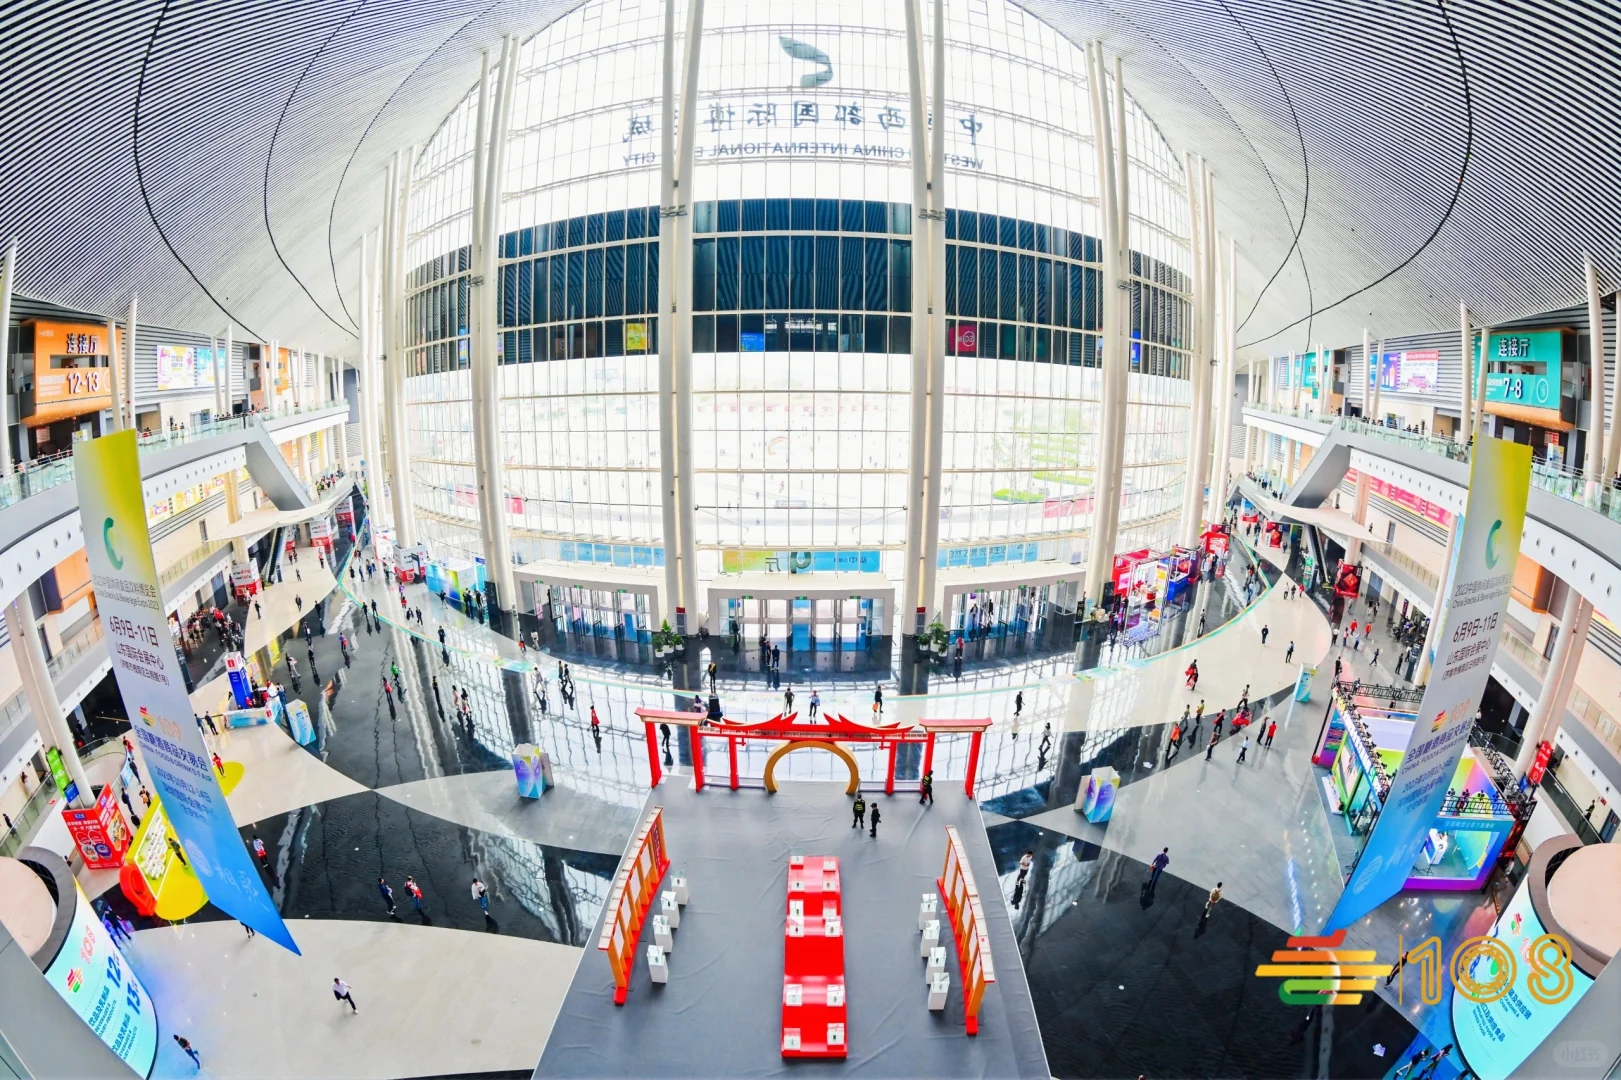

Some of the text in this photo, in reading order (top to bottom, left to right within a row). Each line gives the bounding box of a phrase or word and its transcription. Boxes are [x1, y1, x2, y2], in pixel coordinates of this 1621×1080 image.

[67, 333, 99, 354] 连接厅
[1498, 337, 1529, 357] 连接厅
[1503, 377, 1523, 399] 7-8
[109, 615, 159, 648] 6月9日-11日
[1453, 612, 1499, 643] 6月9日-11日
[135, 724, 208, 772] 全国糖酒商品交易会
[1405, 718, 1473, 764] 全国糖酒商品交易会
[107, 956, 121, 989] 12
[89, 985, 110, 1027] 饮品及乳制品
[106, 999, 117, 1025] PRODUCTS
[127, 982, 141, 1016] 13
[1500, 998, 1509, 1012] CHAIN
[95, 1007, 108, 1033] BEVERAGES
[1478, 1023, 1486, 1036] FOOD
[1485, 1026, 1493, 1038] FOOD
[119, 1034, 130, 1057] EVERAGES
[127, 1026, 138, 1052] PRODUCTS
